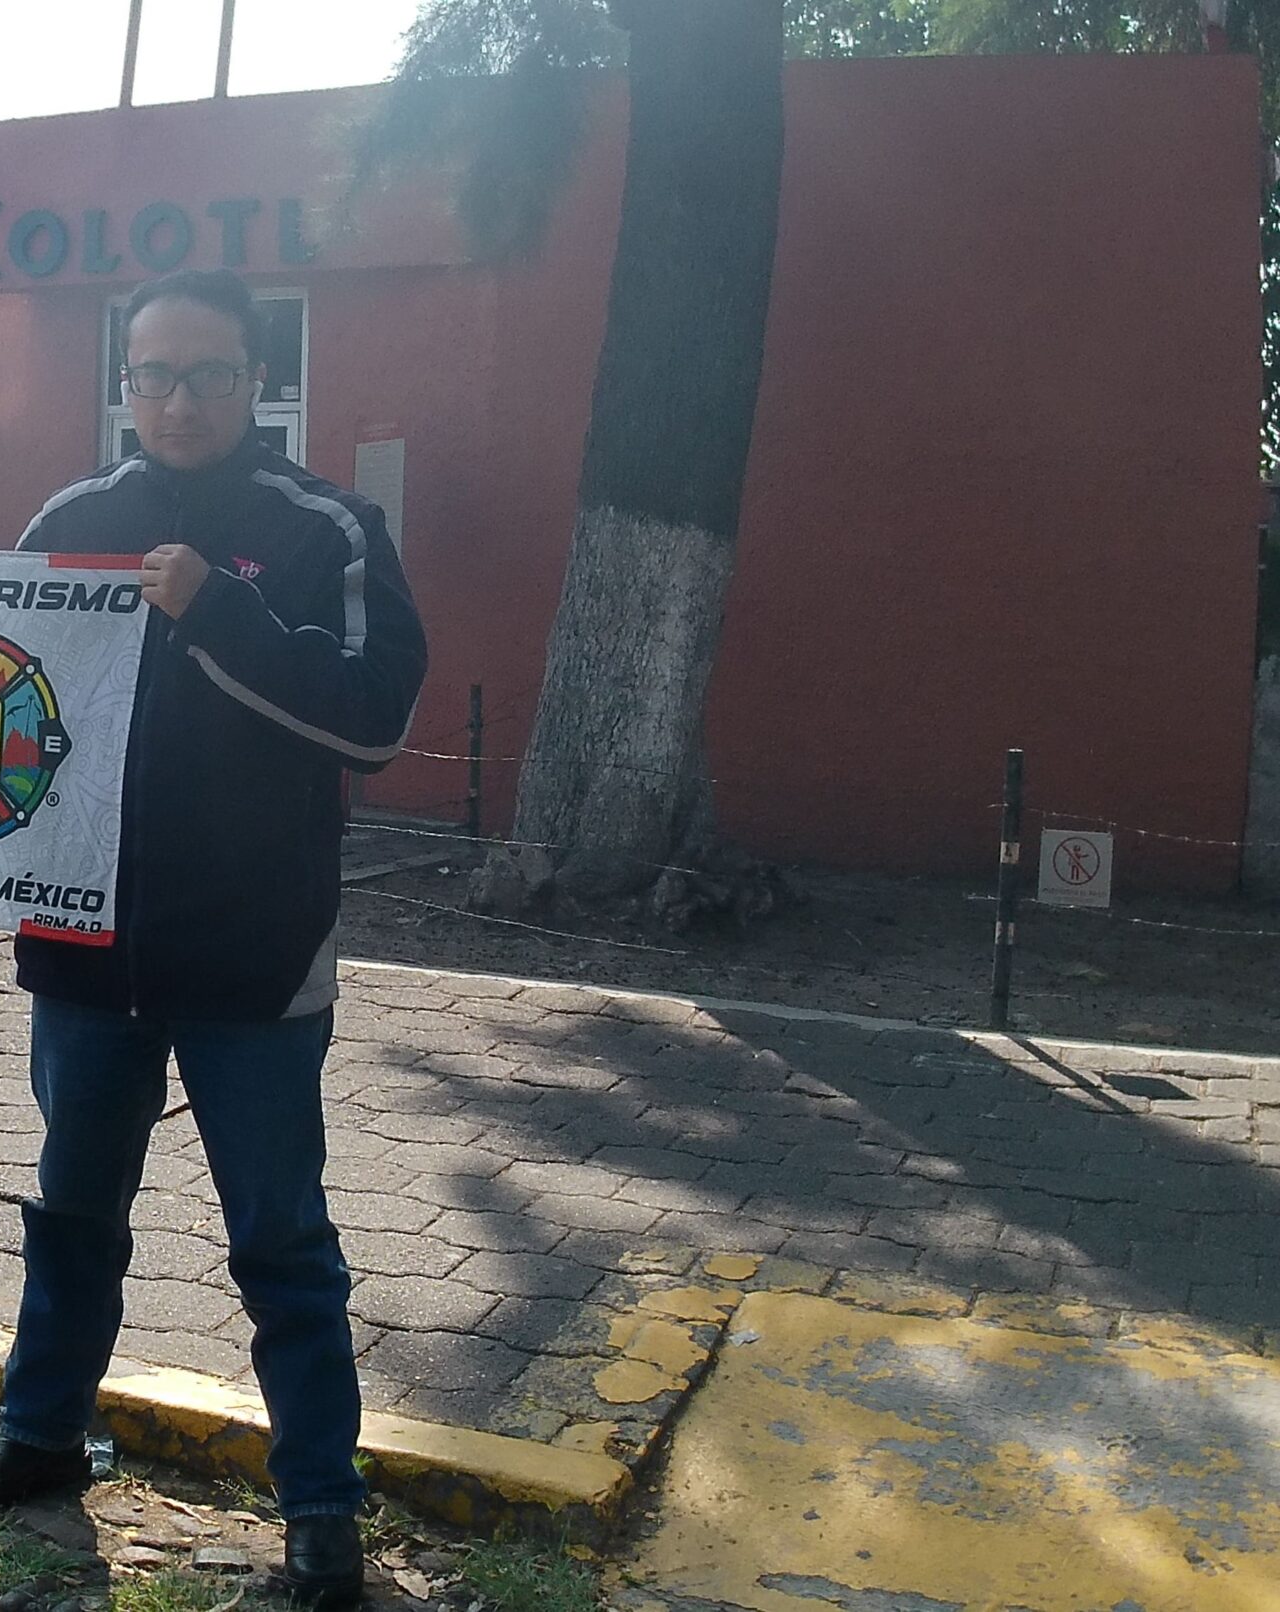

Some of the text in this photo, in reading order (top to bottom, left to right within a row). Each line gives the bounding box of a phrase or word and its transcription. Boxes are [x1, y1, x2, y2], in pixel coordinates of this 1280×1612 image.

[44, 735, 62, 753] E
[33, 913, 103, 933] RRM 4.0
